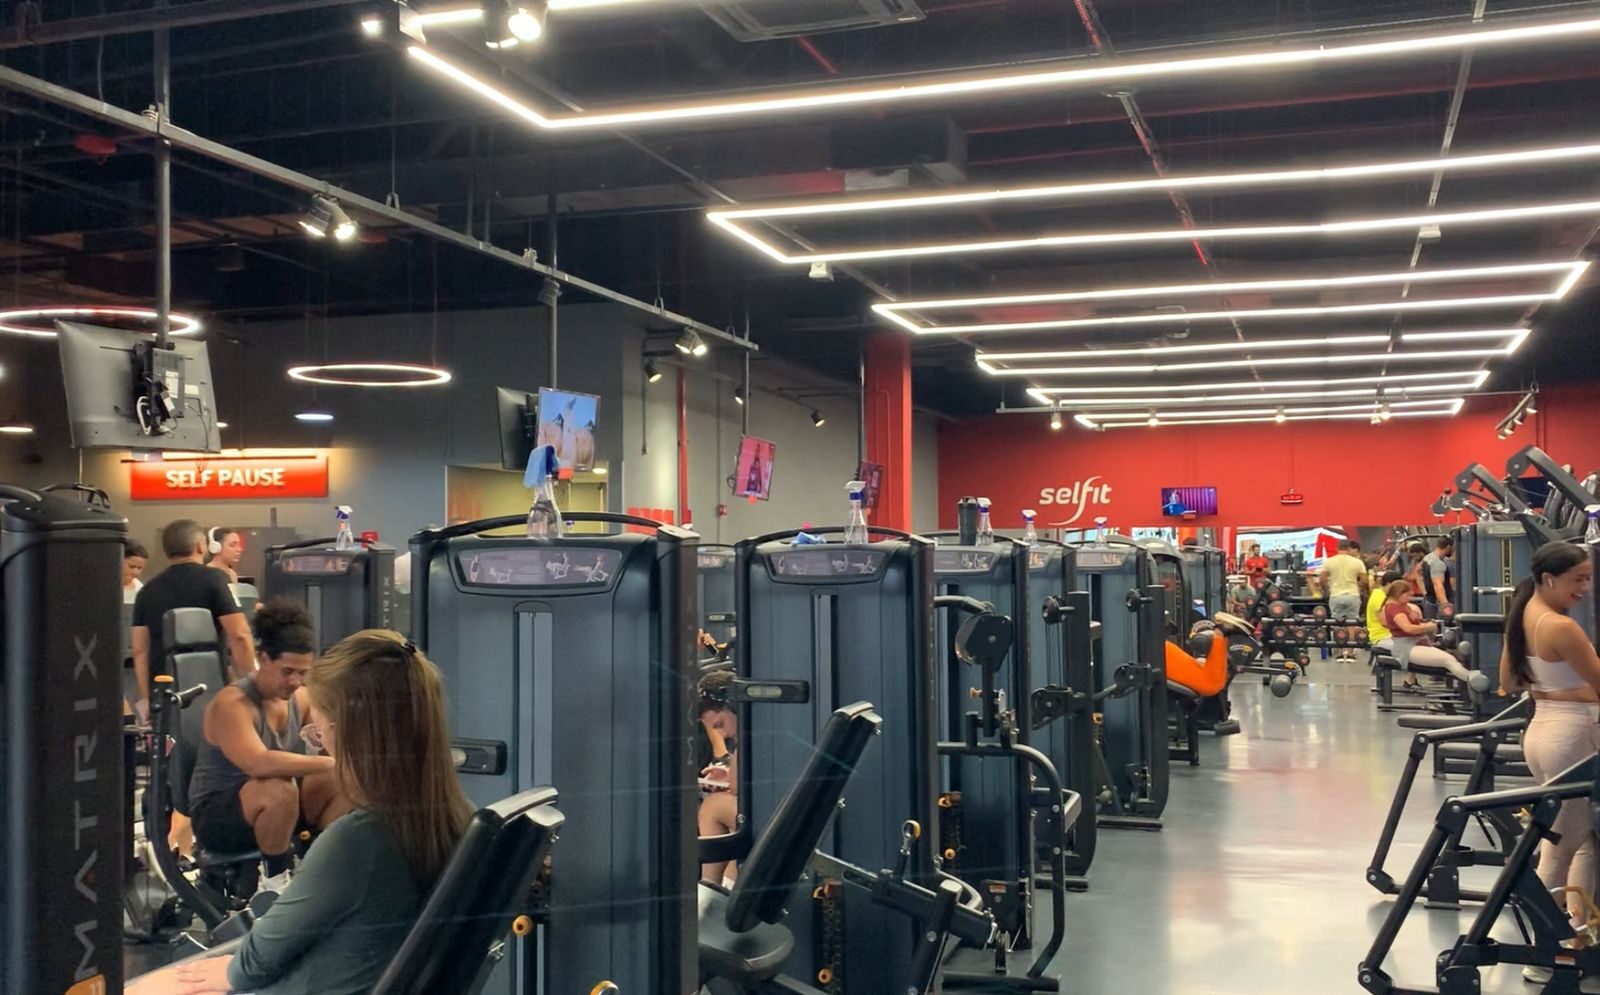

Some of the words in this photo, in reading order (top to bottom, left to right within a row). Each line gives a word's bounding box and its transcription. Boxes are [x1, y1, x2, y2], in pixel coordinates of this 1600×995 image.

[165, 470, 214, 488] SELF
[218, 467, 286, 487] PAUSE
[1039, 475, 1112, 526] selfit
[73, 633, 98, 981] MATRIX
